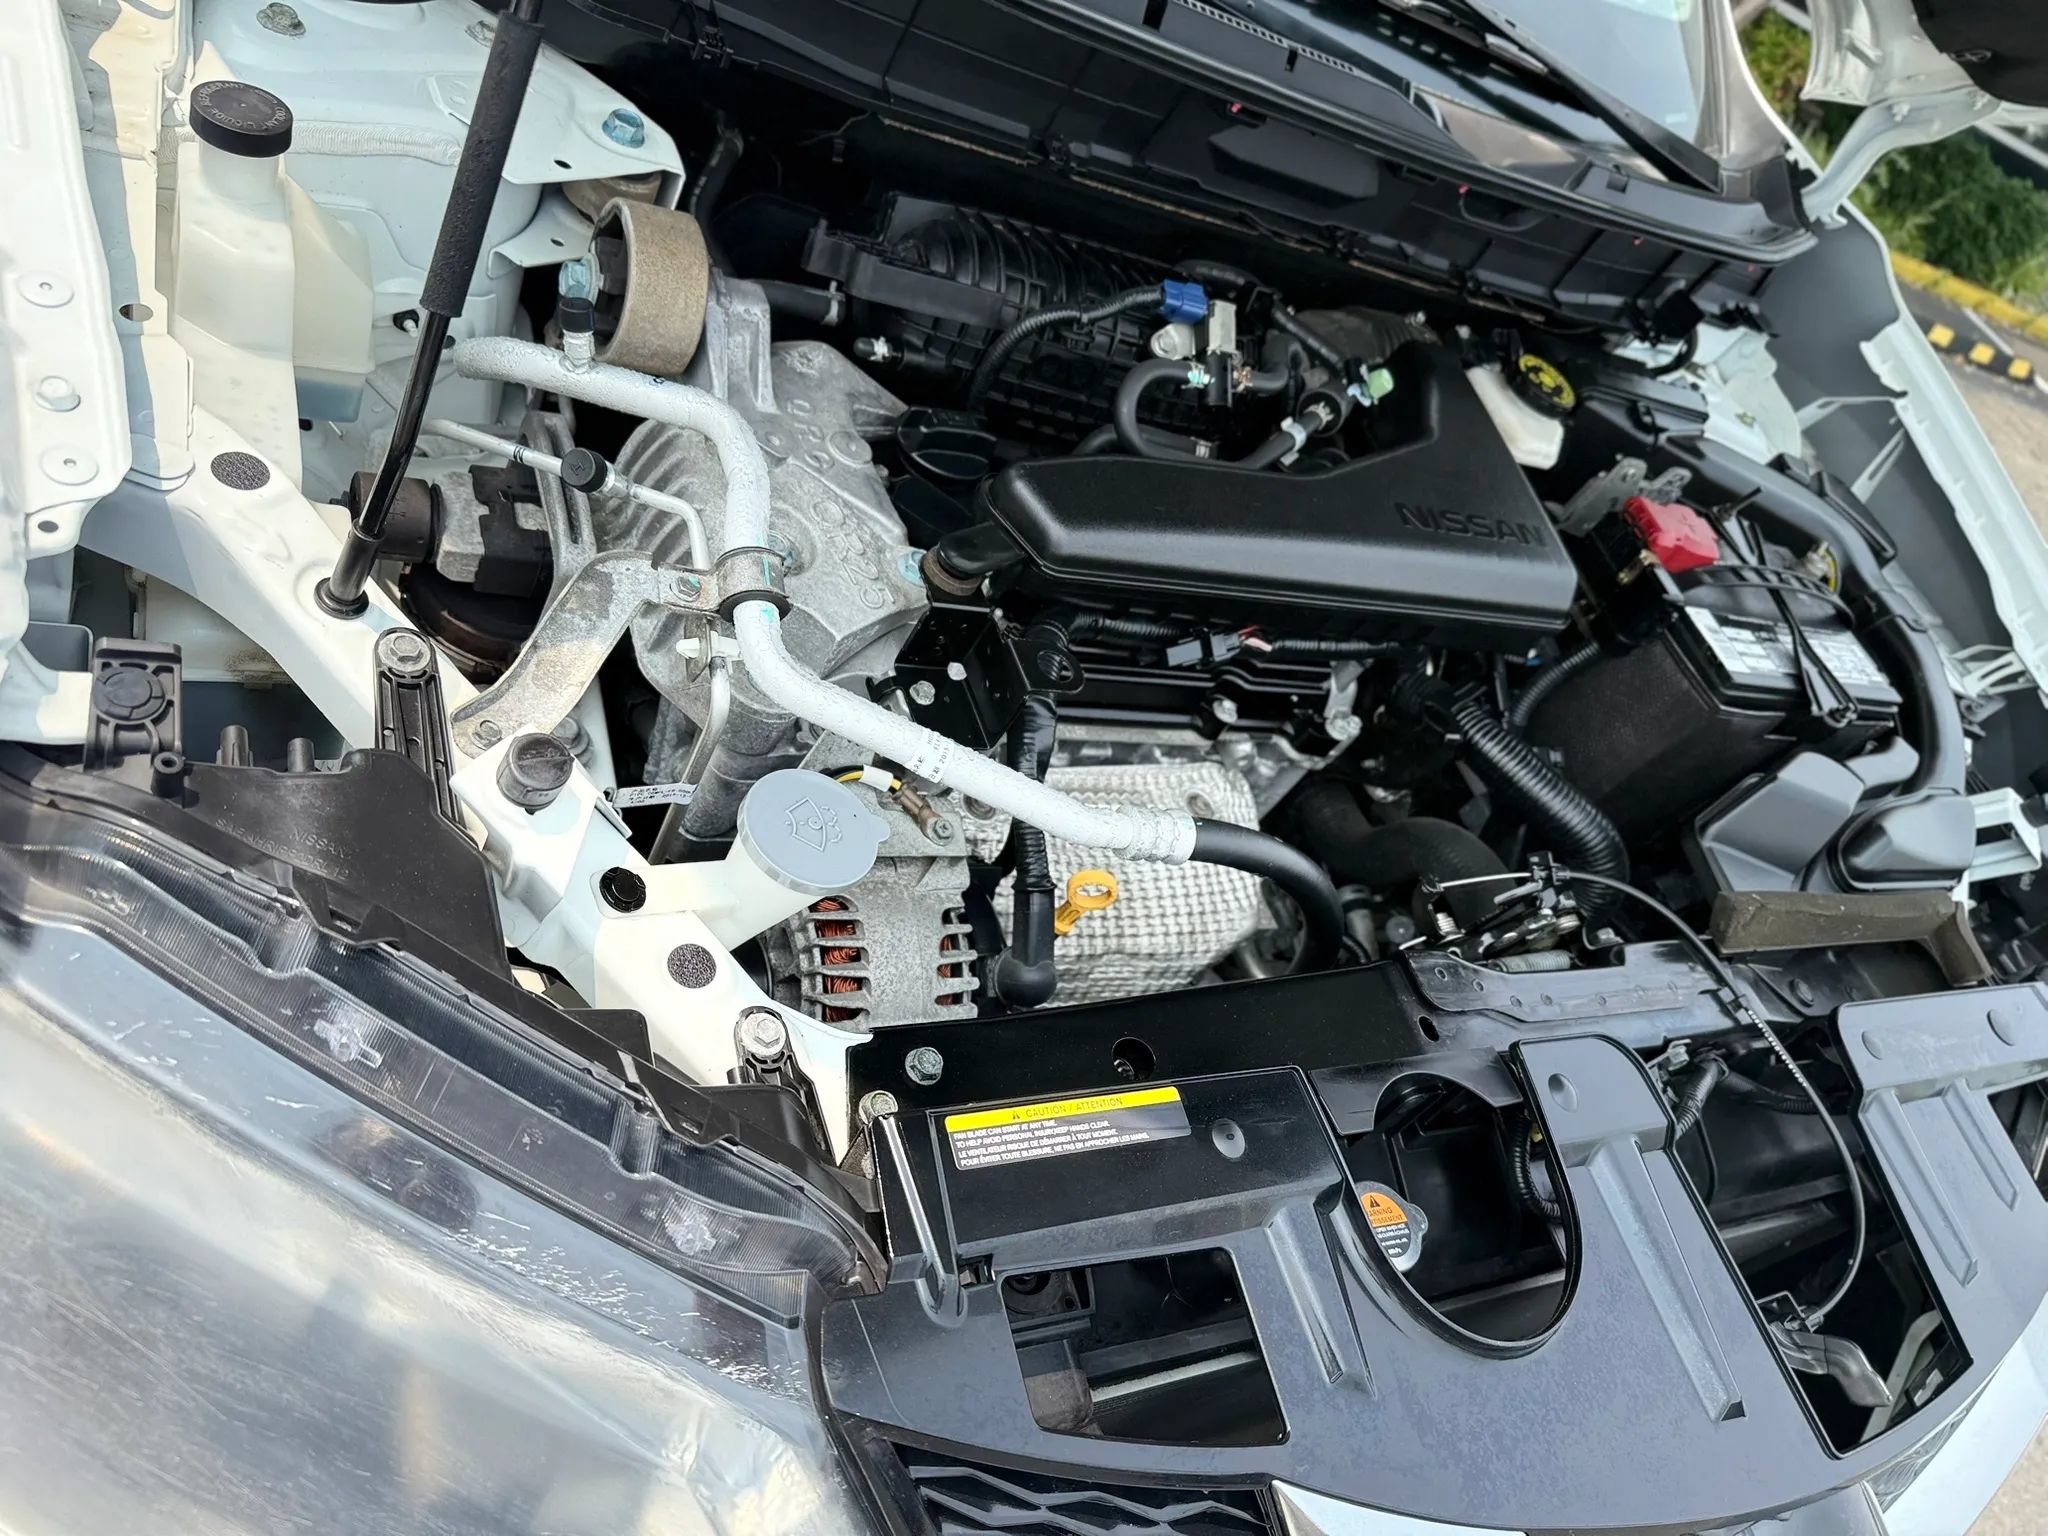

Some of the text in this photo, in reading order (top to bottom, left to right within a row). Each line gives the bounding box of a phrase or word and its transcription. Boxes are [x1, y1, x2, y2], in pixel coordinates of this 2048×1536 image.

[1394, 502, 1548, 547] NISSAN
[809, 499, 896, 609] QR25
[1025, 1104, 1066, 1118] CAUTION
[1076, 1097, 1123, 1111] ATTENTION
[955, 1141, 966, 1149] TO
[966, 1139, 982, 1147] HELP
[983, 1136, 1001, 1144] AVOID
[1002, 1131, 1034, 1142] PERSONAL
[967, 1129, 987, 1138] BLADE
[987, 1127, 1001, 1135] CAN
[1001, 1124, 1021, 1133] START
[1029, 1121, 1041, 1129] ANY
[958, 1151, 967, 1159] LE
[967, 1145, 1007, 1157] VENTILATEUR
[1007, 1142, 1030, 1151] RISQUE
[1076, 1131, 1092, 1140] TOUT
[961, 1158, 979, 1167] POUR
[1001, 1151, 1021, 1160] TOUTE
[1063, 1142, 1075, 1151] PAS
[1367, 1206, 1393, 1217] ARNING
